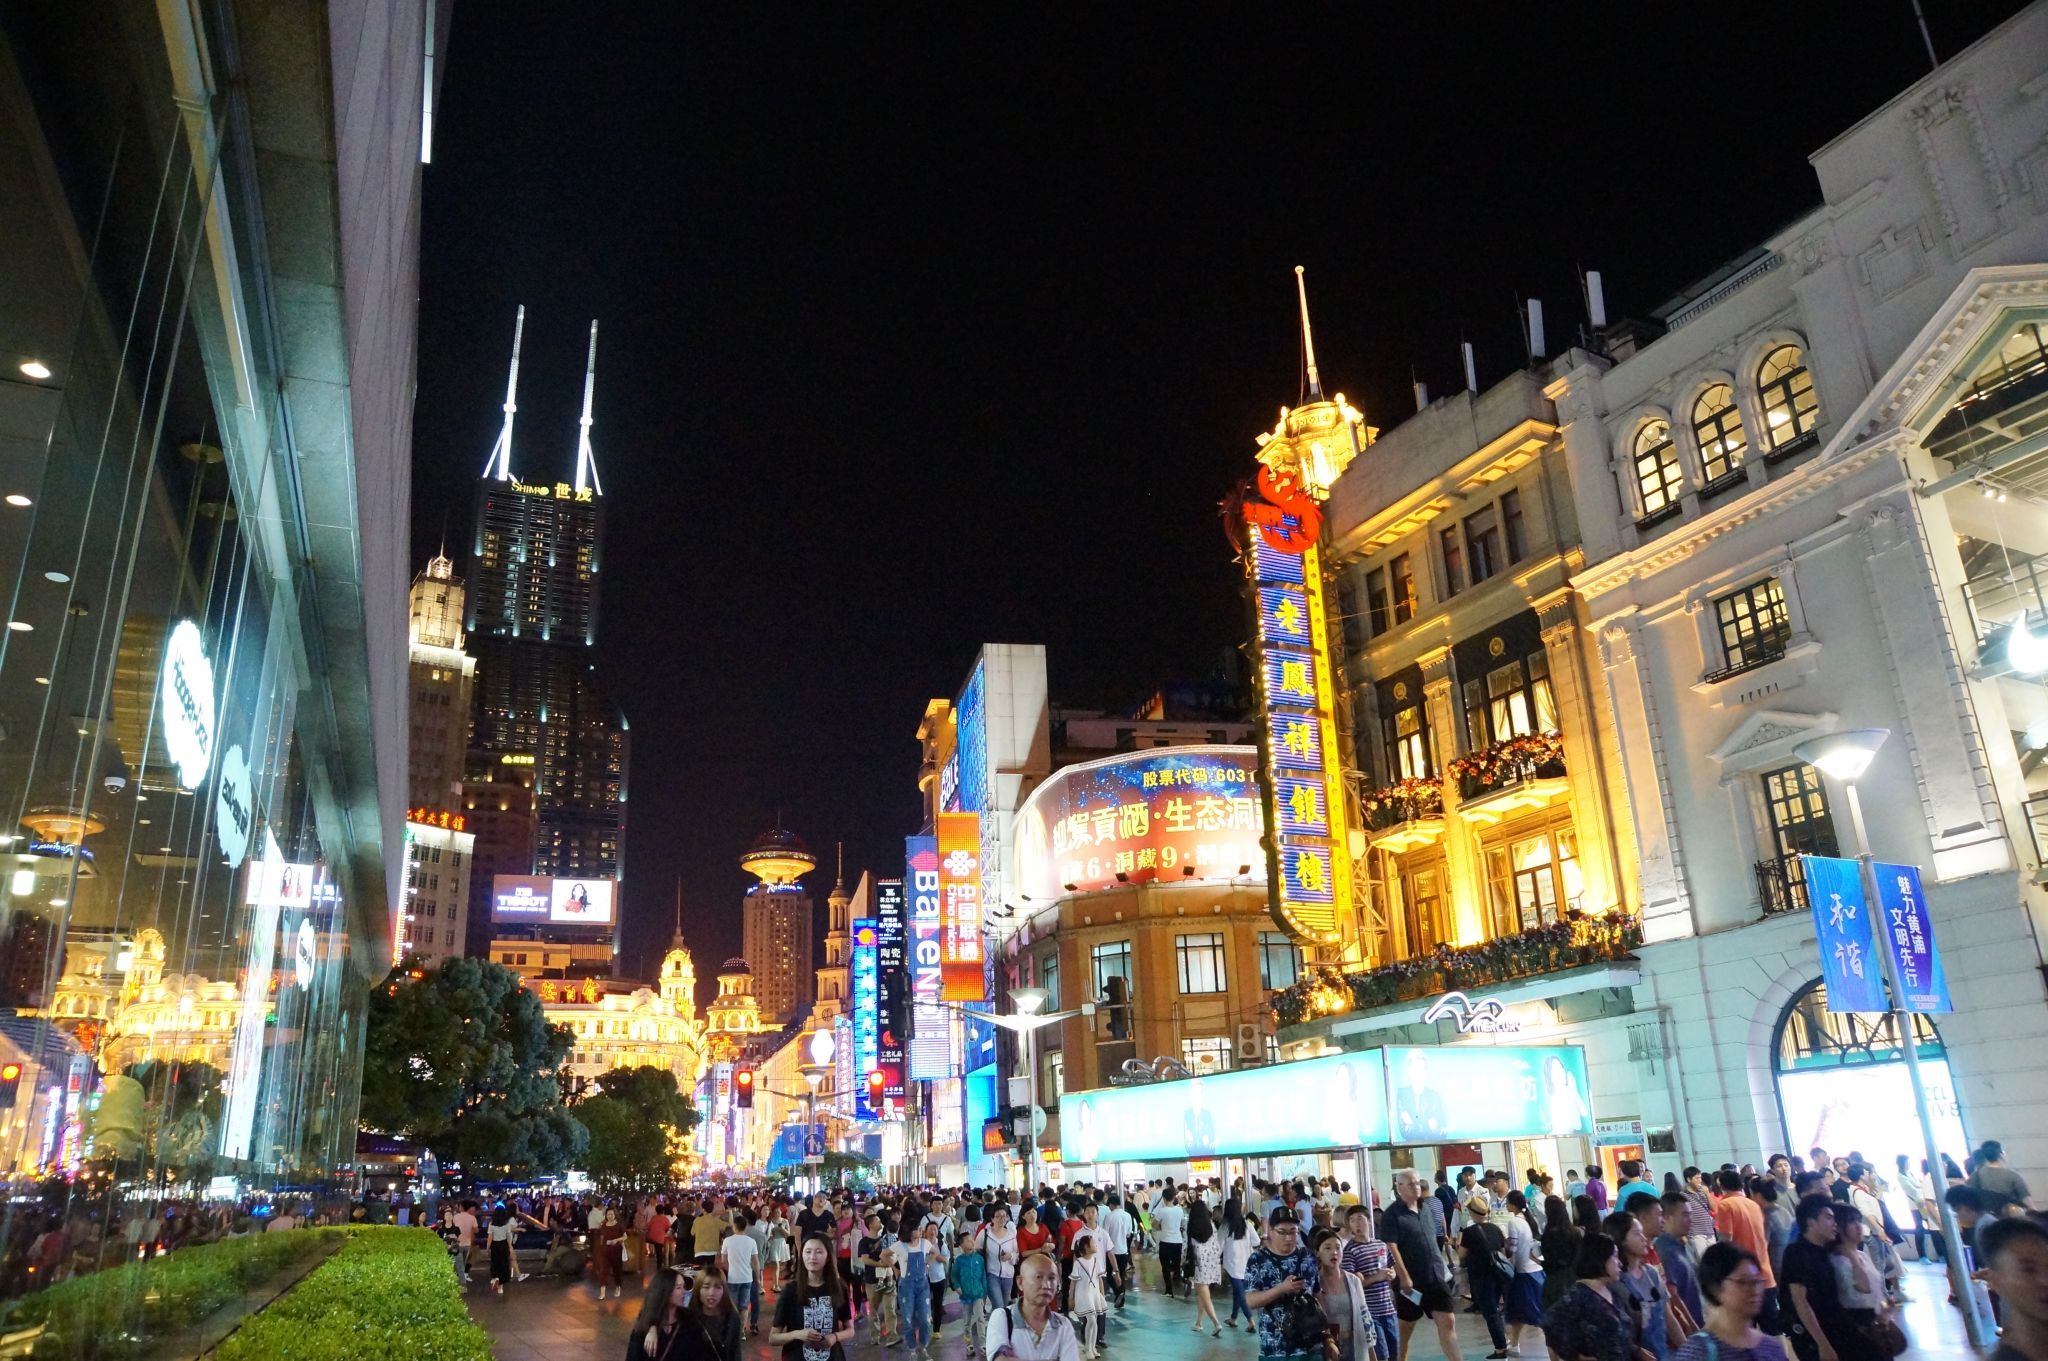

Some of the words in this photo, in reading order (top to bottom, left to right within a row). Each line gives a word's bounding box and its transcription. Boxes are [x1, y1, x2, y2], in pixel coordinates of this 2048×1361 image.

[554, 482, 593, 503] 世茂
[880, 948, 901, 958] 陶瓷
[957, 884, 978, 960] 中国联通
[1829, 893, 1864, 980] 和谐
[1889, 907, 1919, 988] 文明先行
